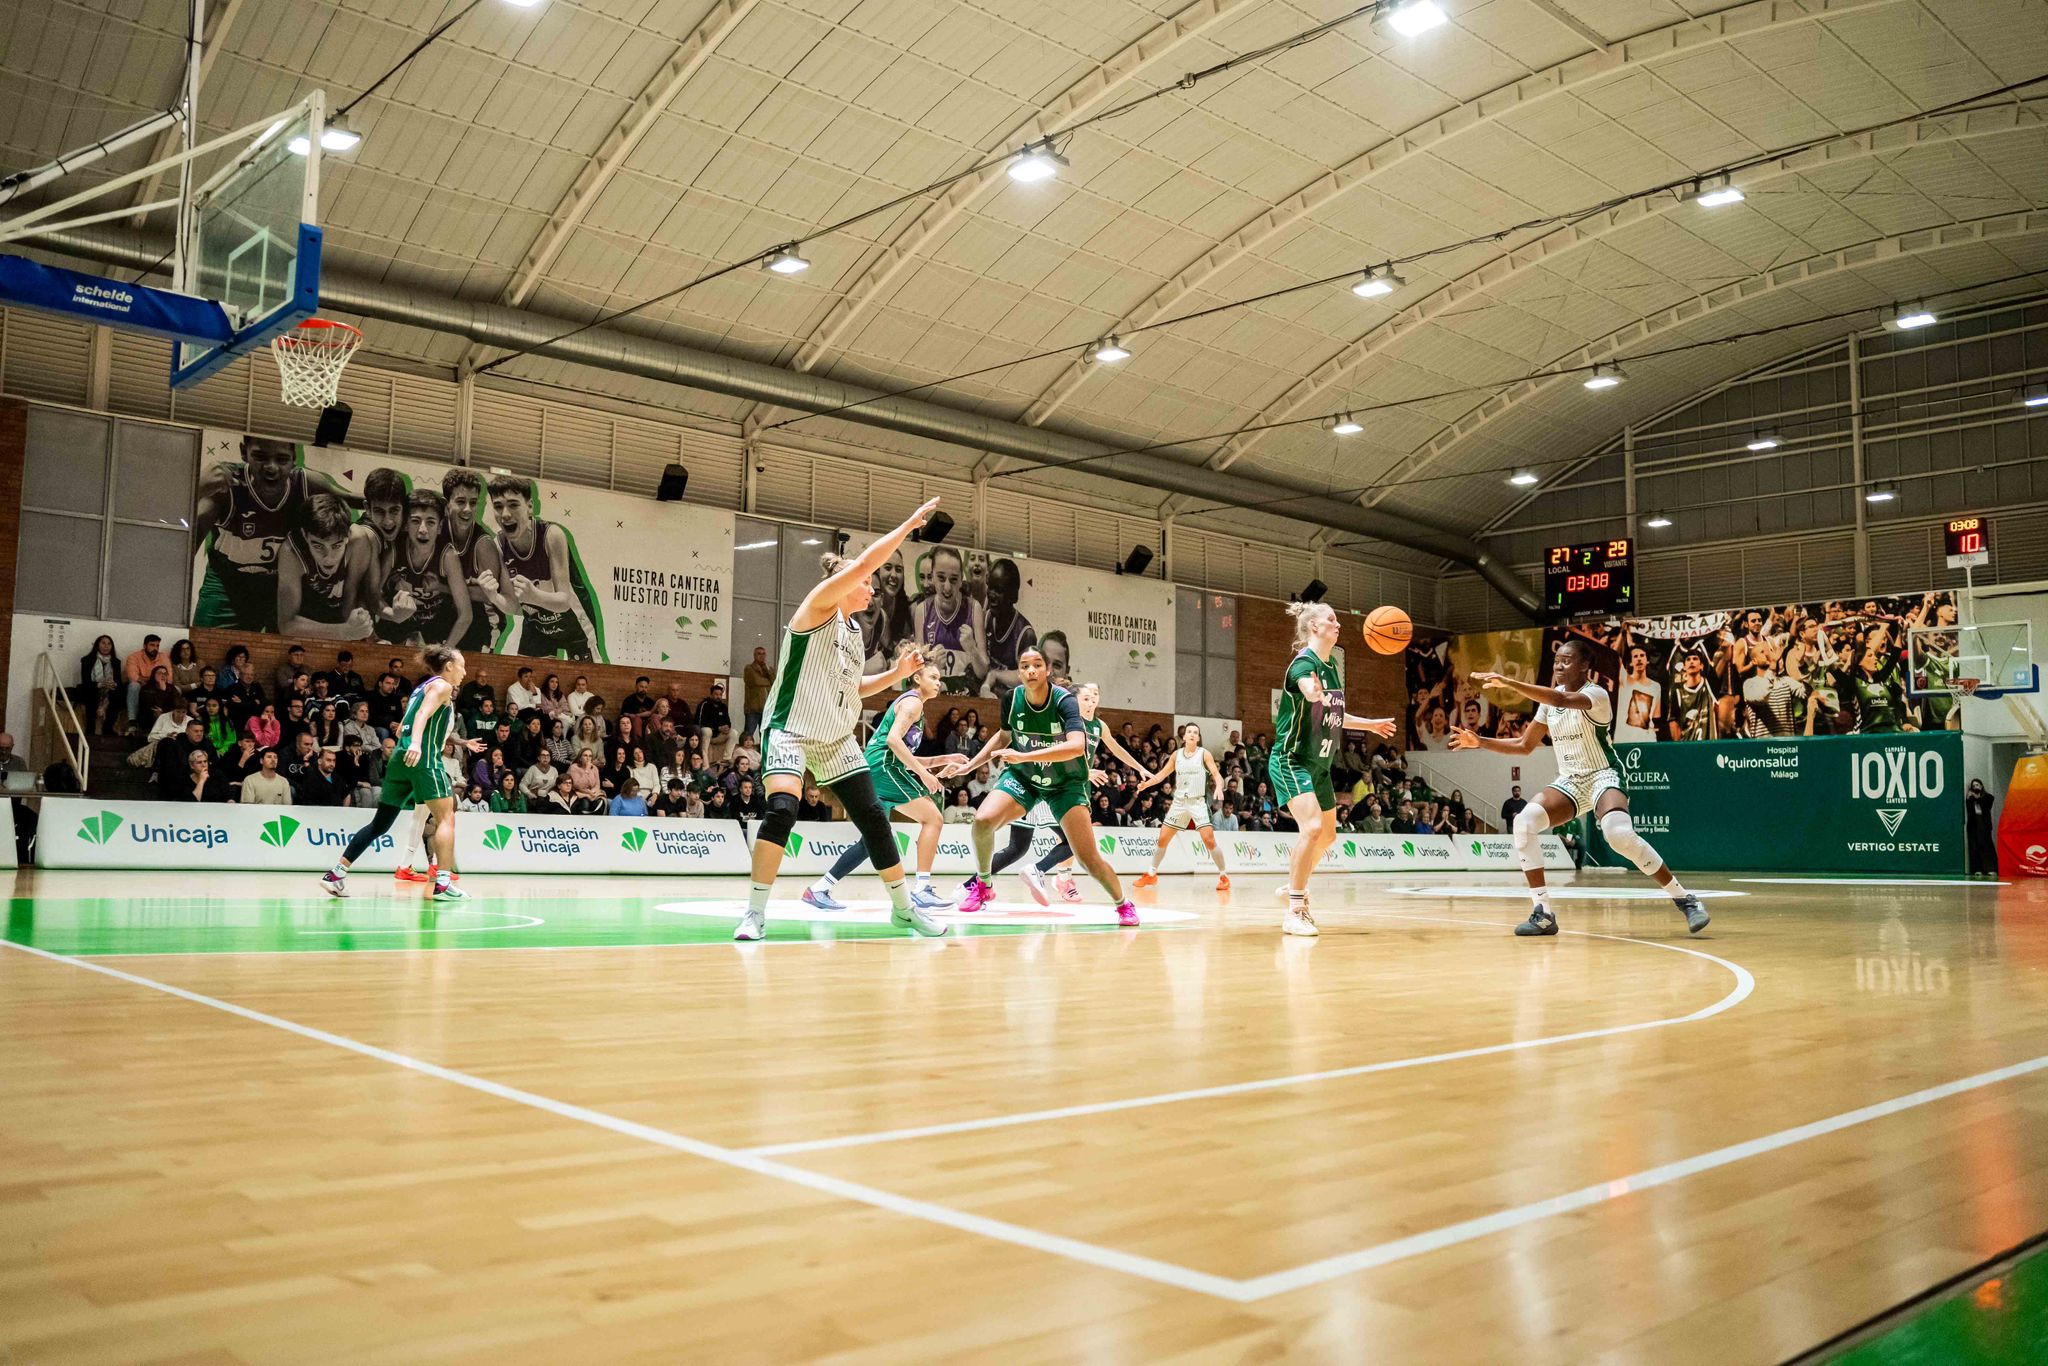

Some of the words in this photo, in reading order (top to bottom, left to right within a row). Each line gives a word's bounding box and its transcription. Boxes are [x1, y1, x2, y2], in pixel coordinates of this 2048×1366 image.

[76, 284, 133, 303] schelde
[72, 295, 130, 312] international
[1608, 541, 1627, 557] 29
[1962, 534, 1979, 552] 10
[1552, 548, 1570, 563] 27
[1583, 552, 1591, 565] 2
[1548, 566, 1570, 574] LOCAL
[1604, 559, 1627, 568] VISITANTE
[614, 566, 664, 587] NUESTRA
[670, 574, 720, 594] CANTERA
[1568, 574, 1608, 591] 03:08
[614, 585, 668, 606] NUESTRO
[674, 592, 718, 612] FUTURO
[1622, 586, 1630, 597] 4
[1088, 611, 1122, 626] NUESTRA
[1124, 616, 1156, 631] CANTERA
[1088, 626, 1124, 642] NUESTRO
[1128, 630, 1156, 646] FUTURO
[1554, 732, 1584, 742] Juniper
[1319, 738, 1332, 758] 21
[1767, 746, 1798, 754] Hospital
[1770, 771, 1798, 779] Málaga
[130, 824, 228, 848] Unicaja
[306, 828, 394, 852] Unija
[518, 827, 598, 840] Fundación
[652, 830, 726, 843] Fundación
[522, 840, 580, 856] Unicaja
[656, 843, 710, 858] Unicaja
[809, 841, 857, 856] Unic
[1234, 841, 1261, 860] Mijas
[1360, 846, 1394, 859] Unicaja
[1417, 847, 1450, 859] Unicaja
[1848, 843, 1895, 851] VERTIGO
[1898, 843, 1940, 852] ESTATE
